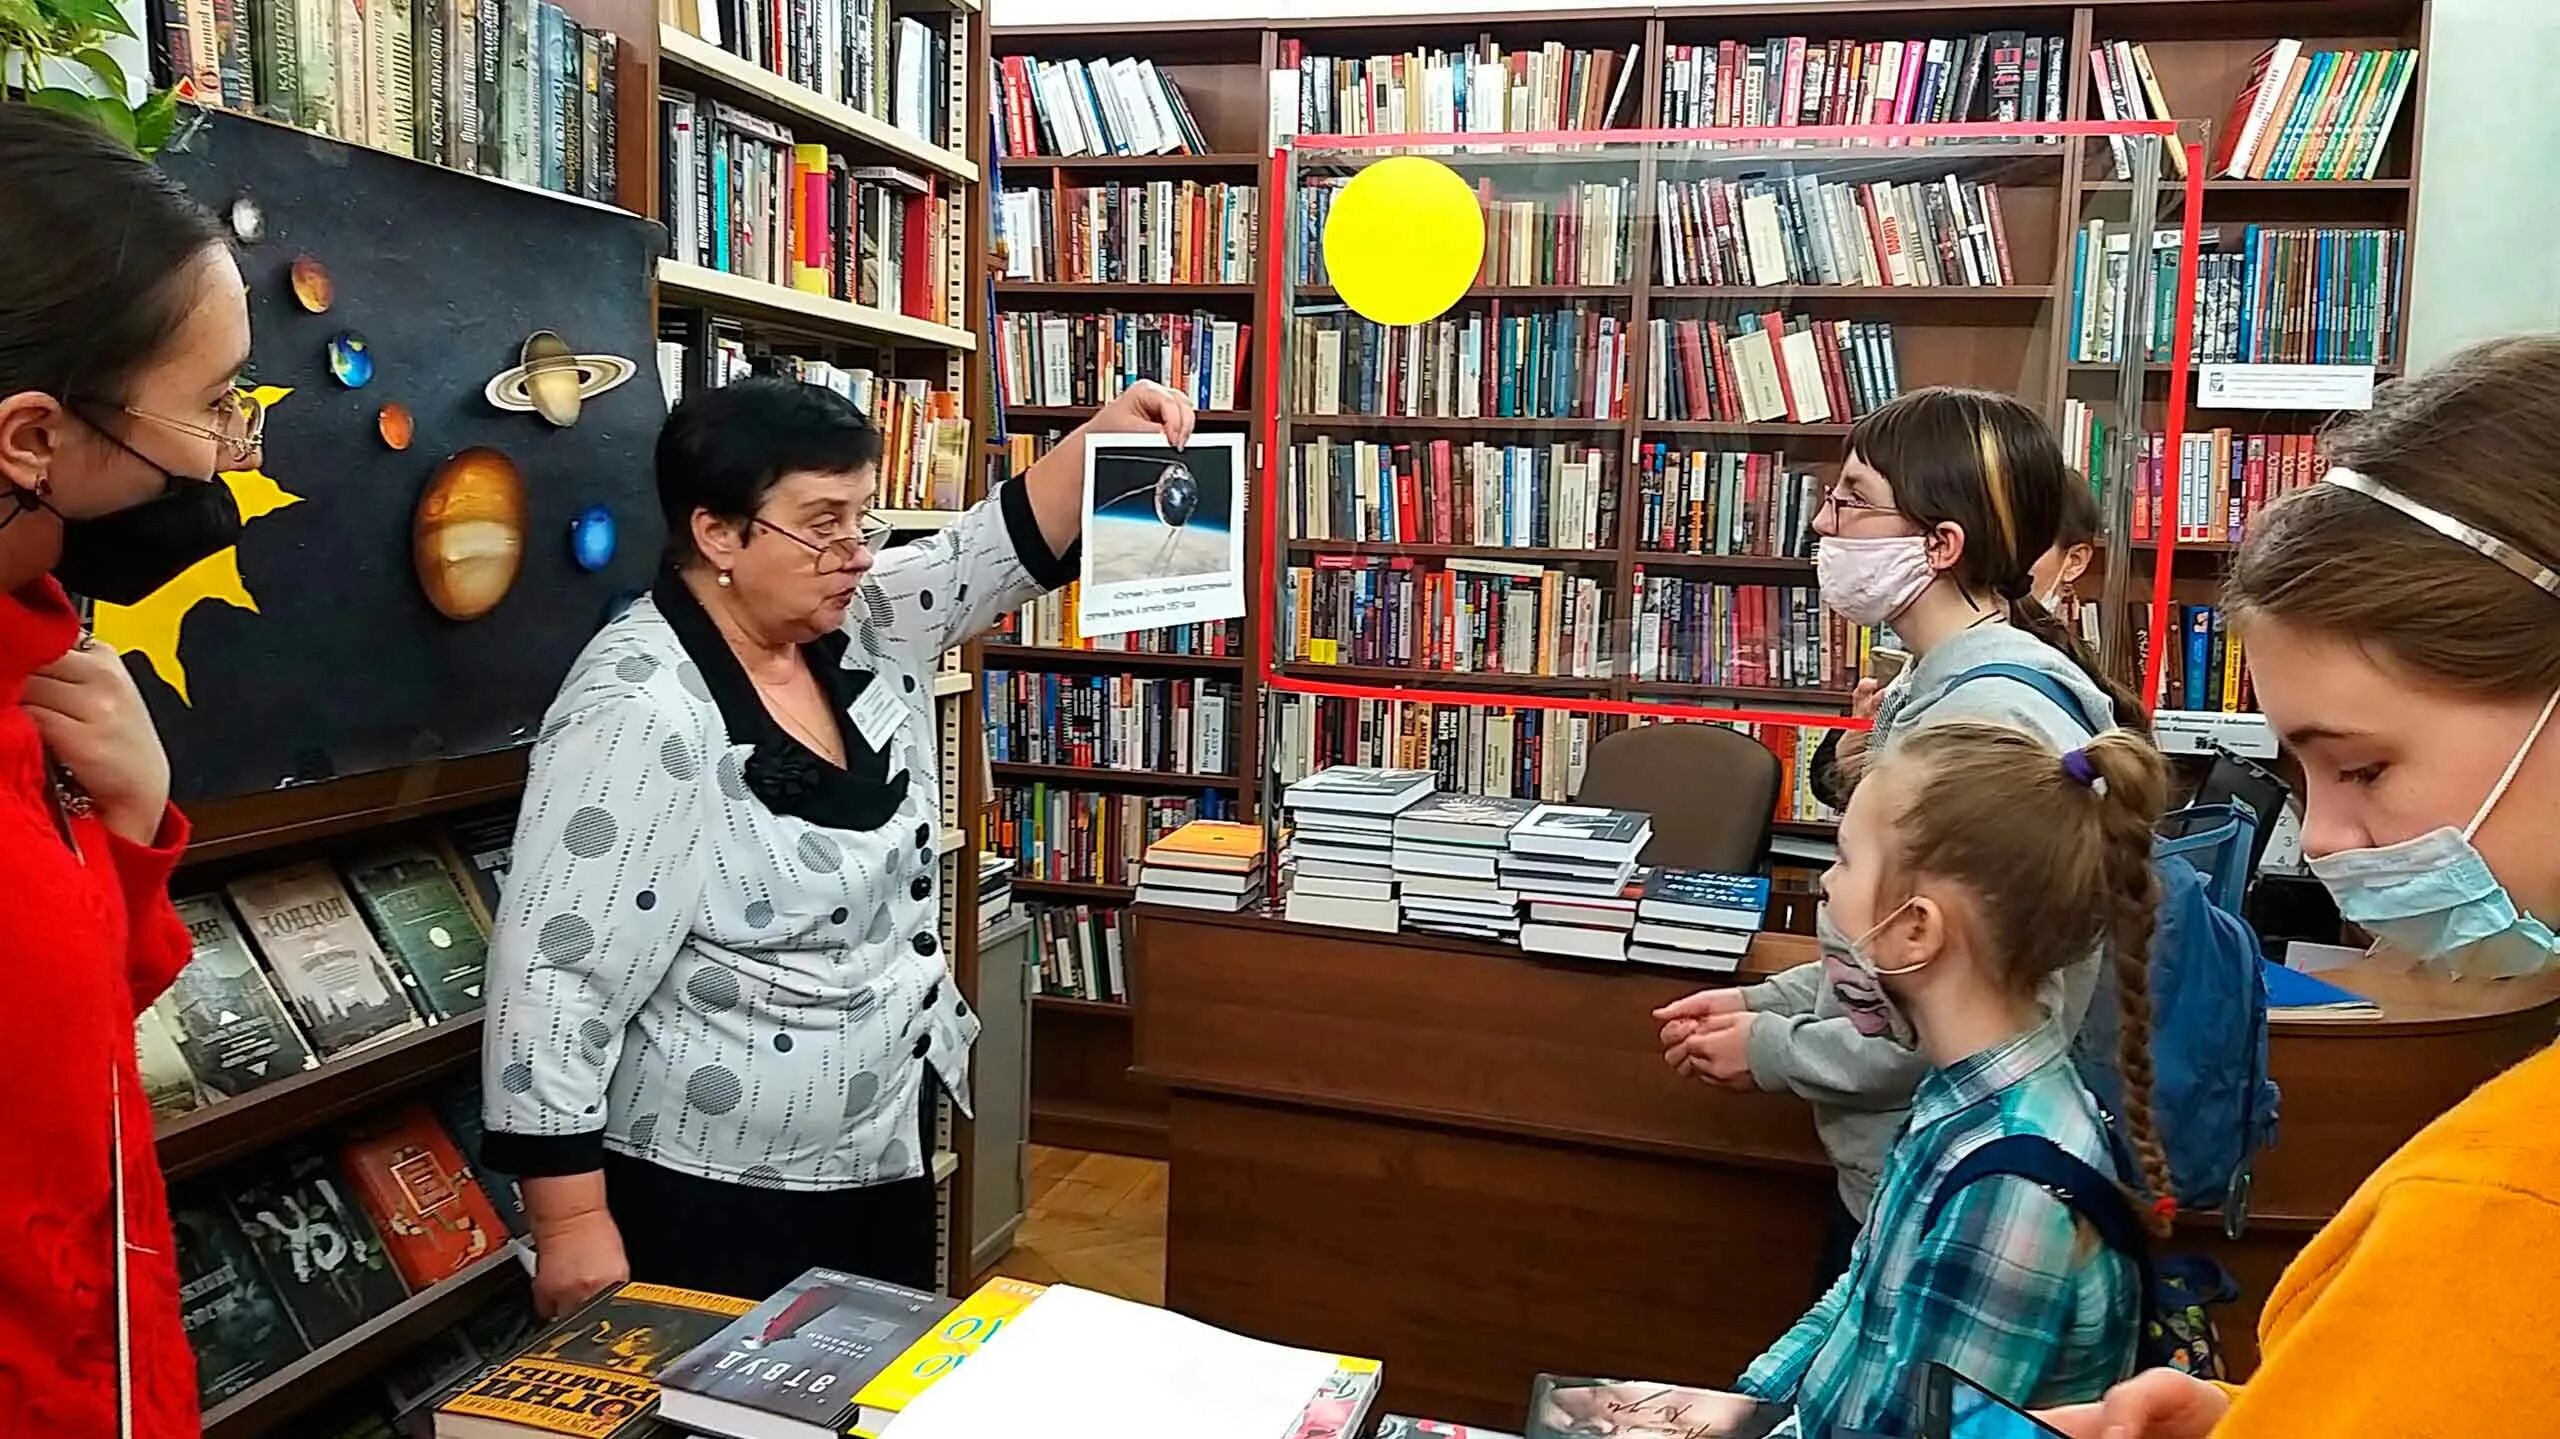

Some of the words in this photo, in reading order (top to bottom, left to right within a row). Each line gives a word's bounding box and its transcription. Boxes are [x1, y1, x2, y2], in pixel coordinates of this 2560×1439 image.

[1881, 216, 1902, 256] ПАМЯТЬ
[1437, 710, 1450, 741] БЕРИЯ
[1450, 711, 1458, 739] БЕРИЯ
[472, 1377, 638, 1420] ОГНИ
[495, 1364, 660, 1403] РАМПЫ
